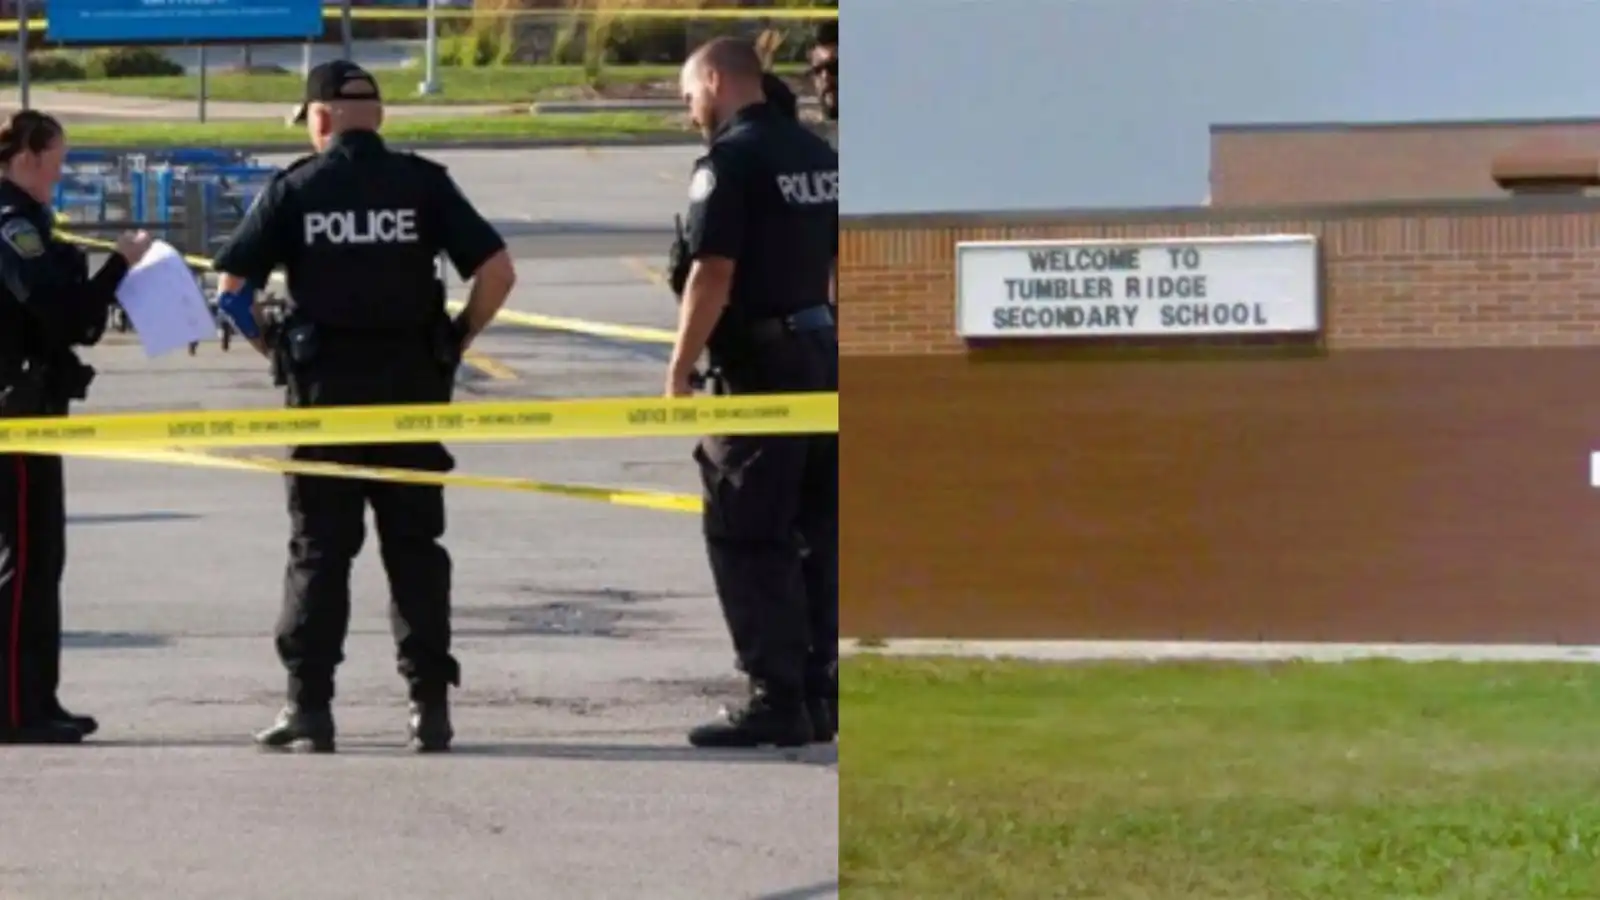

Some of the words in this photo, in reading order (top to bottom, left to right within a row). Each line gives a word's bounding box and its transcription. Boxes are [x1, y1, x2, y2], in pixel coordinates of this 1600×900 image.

[304, 209, 418, 245] POLICE
[1029, 248, 1139, 272] WELCOME
[1167, 248, 1200, 270] TO
[1004, 277, 1112, 301] TUMBLER
[1125, 276, 1207, 298] RIDGE
[992, 305, 1139, 329] SECONDARY
[1161, 303, 1268, 326] SCHOOL
